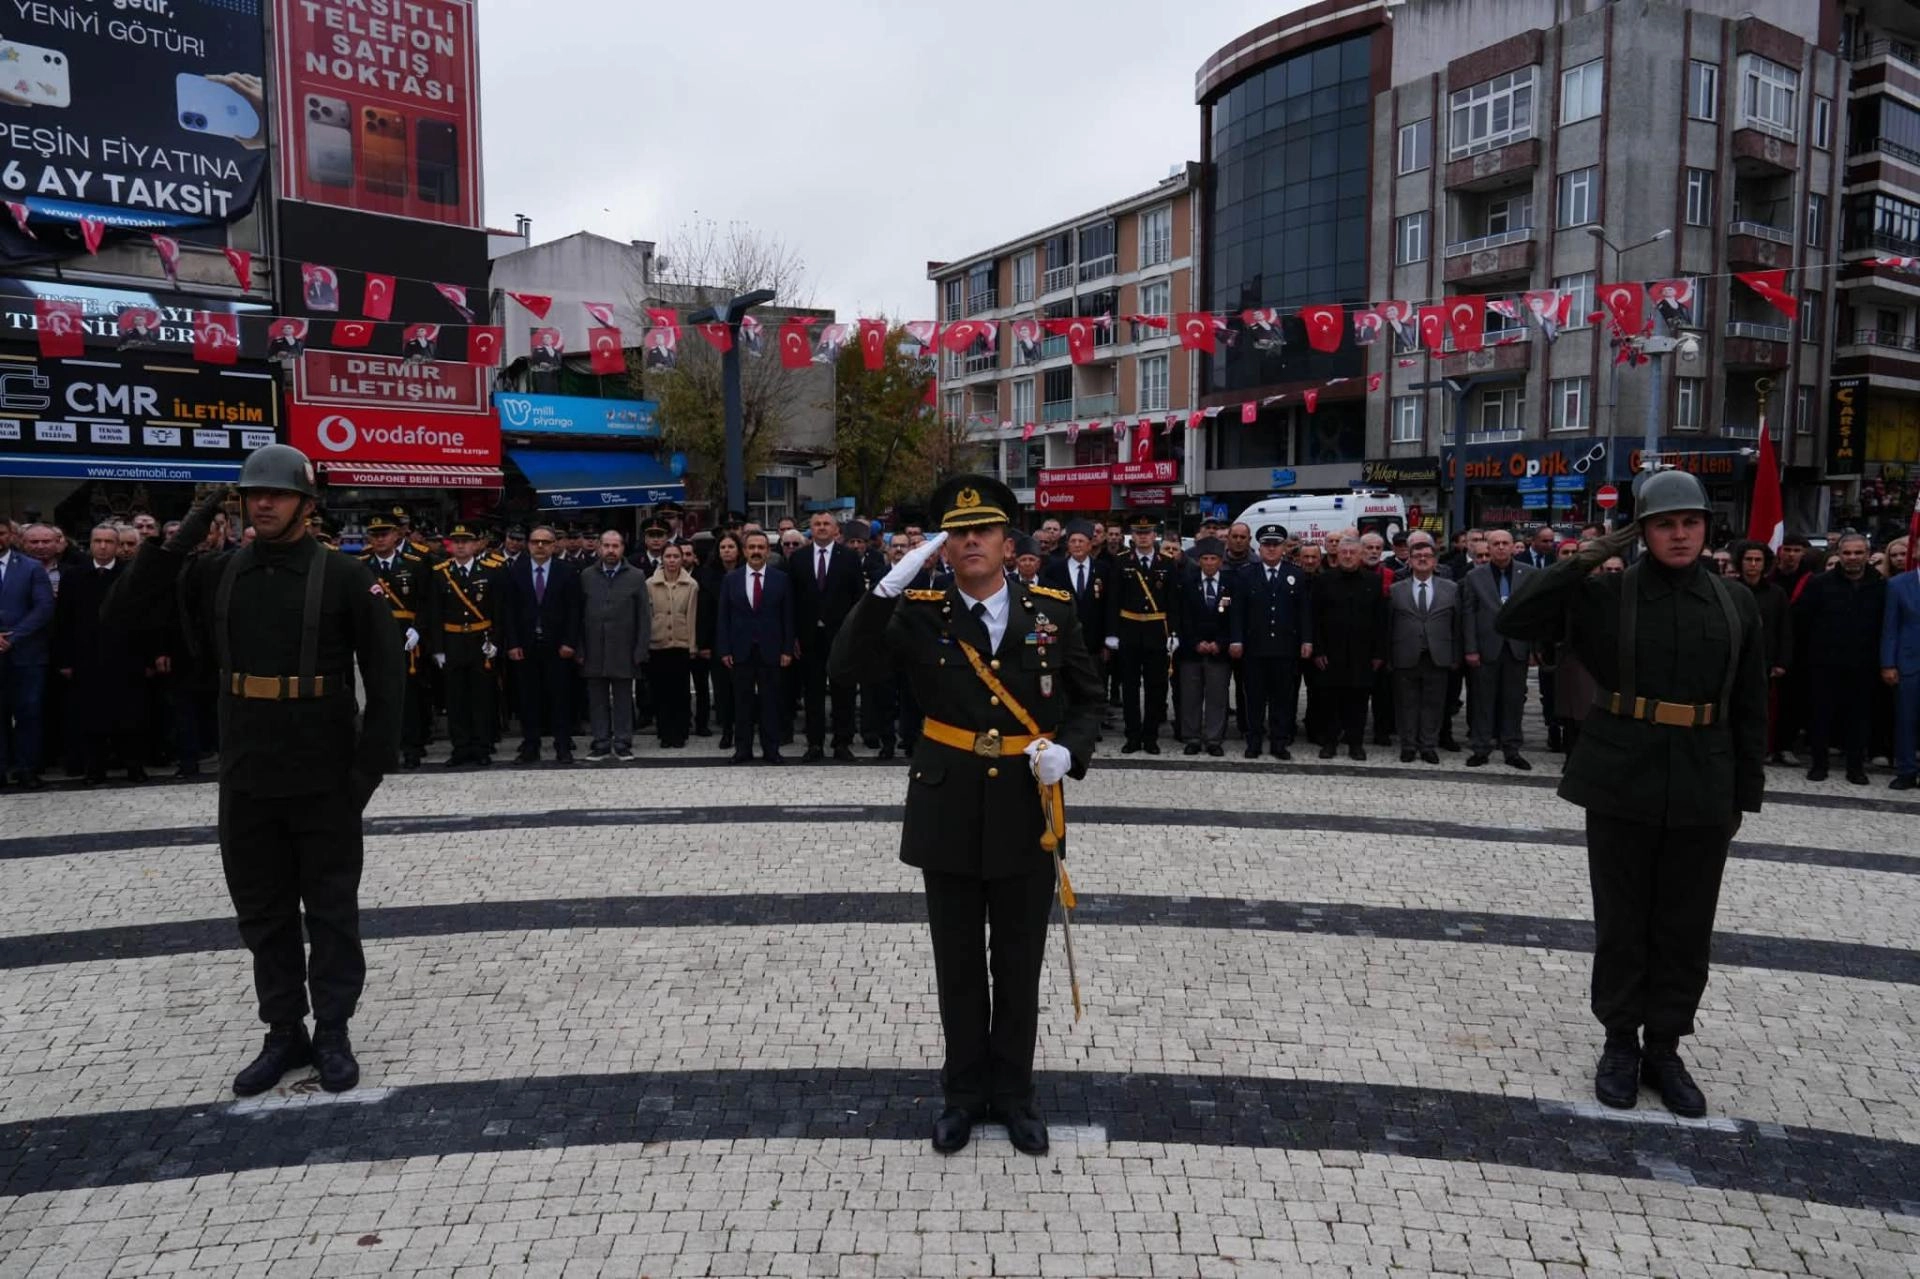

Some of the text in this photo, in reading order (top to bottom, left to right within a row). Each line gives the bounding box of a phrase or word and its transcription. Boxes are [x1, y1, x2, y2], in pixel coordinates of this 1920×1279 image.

[14, 0, 206, 58] YENİYİ GÖTÜR!
[300, 1, 454, 57] TELEFON
[332, 33, 430, 78] SATIŞ
[305, 51, 454, 104] NOKTASI
[102, 136, 243, 183] FİYATINA
[2, 160, 233, 218] 6 AY TAKSİT
[347, 359, 441, 380] DEMİR
[329, 375, 457, 401] İLETİŞİM
[65, 381, 263, 423] CMR İLETİŞİM
[532, 406, 555, 417] milli
[361, 425, 465, 447] vodafone
[532, 416, 574, 429] piyango
[87, 466, 192, 480] www.cnetmobil.com
[1509, 451, 1569, 478] Optik
[352, 473, 406, 484] VODAFONE
